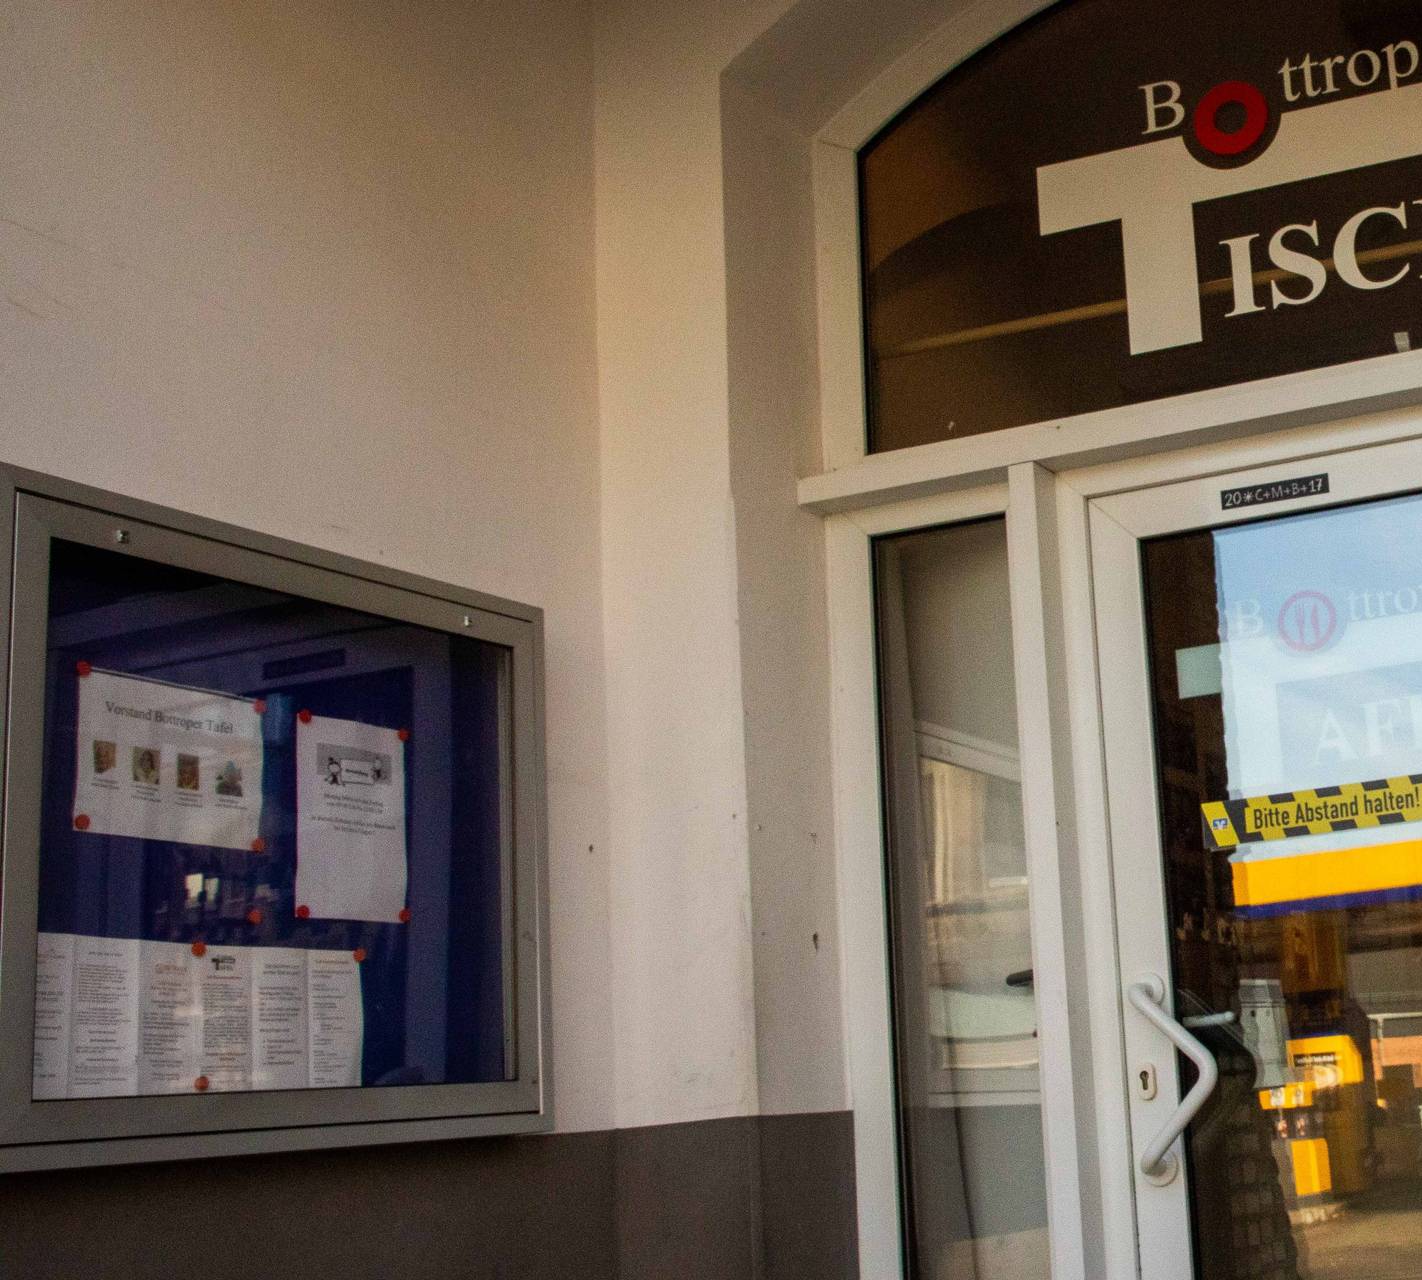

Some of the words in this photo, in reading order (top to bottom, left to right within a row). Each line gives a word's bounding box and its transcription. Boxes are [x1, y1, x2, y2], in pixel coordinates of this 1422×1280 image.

[105, 701, 152, 721] Vorstand
[154, 711, 203, 731] Bottroper
[207, 719, 234, 734] Tafel
[1253, 805, 1290, 830] Bitte
[1295, 796, 1358, 824] Abstand
[1364, 787, 1420, 815] halten!
